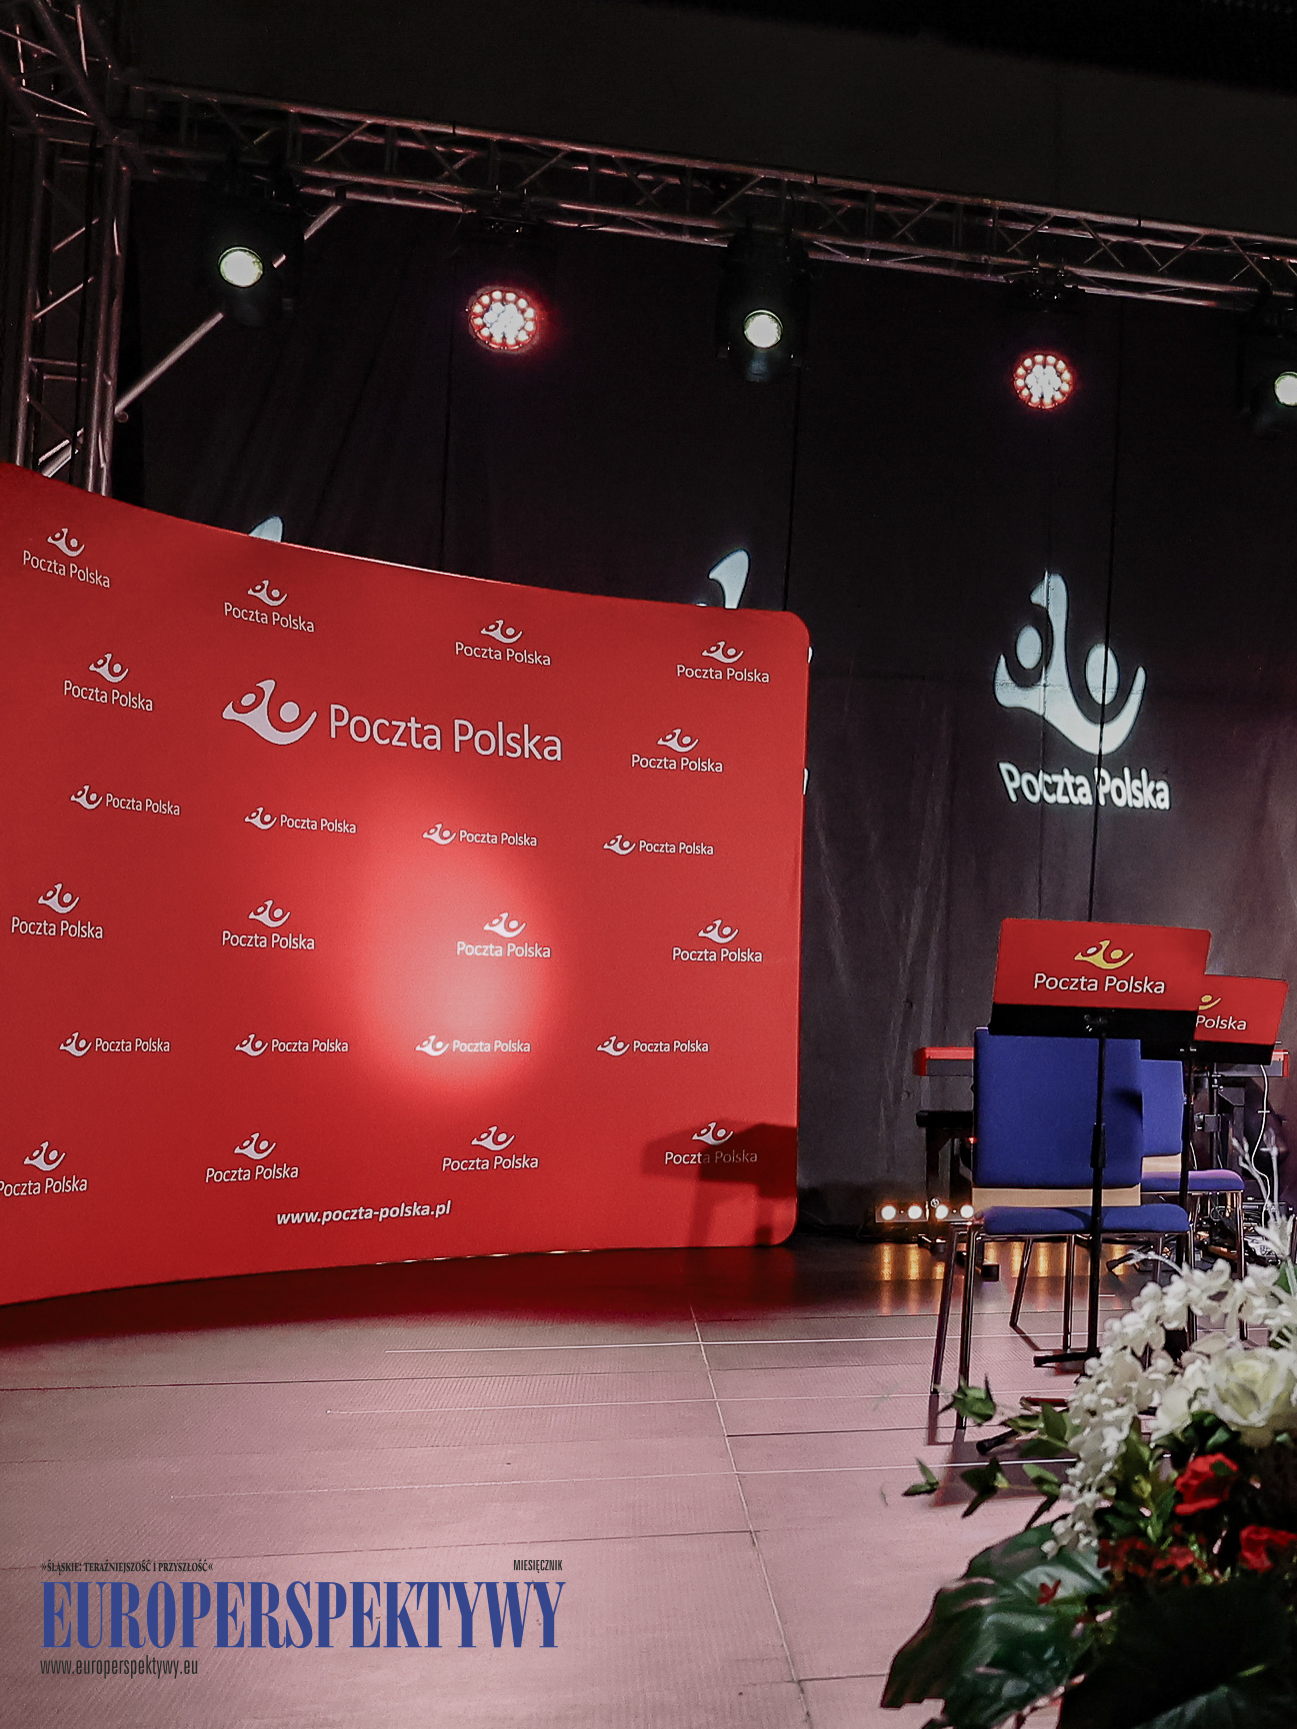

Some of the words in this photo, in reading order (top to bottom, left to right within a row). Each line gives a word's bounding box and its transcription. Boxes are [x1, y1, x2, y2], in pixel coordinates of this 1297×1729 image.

[23, 550, 66, 576] Poczta
[70, 563, 111, 588] Polska
[224, 602, 268, 625] Poczta
[273, 612, 315, 632] Polska
[455, 642, 502, 661] Poczta
[506, 647, 551, 666] Polska
[677, 665, 722, 681] Poczta
[727, 667, 770, 683] Polska
[64, 680, 108, 703] Poczta
[112, 690, 154, 711] Polska
[330, 704, 442, 751] Poczta
[453, 719, 563, 761] Polska
[631, 754, 677, 770] Poczta
[680, 757, 723, 773] Polska
[999, 762, 1093, 806] Poczta
[1094, 767, 1171, 810] Polska
[106, 794, 142, 812] Poczta
[145, 799, 180, 816] Polska
[280, 814, 318, 831] Poczta
[320, 818, 357, 834] Polska
[459, 830, 498, 845] Poczta
[501, 832, 538, 847] Polska
[639, 840, 676, 855] Poczta
[679, 842, 714, 856] Polska
[11, 916, 56, 937] Poczta
[60, 920, 103, 939] Polska
[222, 931, 267, 949] Poczta
[271, 933, 315, 951] Polska
[457, 941, 503, 957] Poczta
[507, 943, 551, 958] Polska
[673, 947, 717, 963] Poczta
[720, 948, 762, 963] Polska
[1033, 973, 1098, 992] Poczta
[1104, 976, 1165, 994] Polska
[1195, 1015, 1247, 1030] Polska
[95, 1038, 132, 1053] Poczta
[135, 1037, 170, 1053] Polska
[271, 1039, 309, 1053] Poczta
[312, 1039, 349, 1053] Polska
[452, 1040, 491, 1053] Poczta
[494, 1040, 531, 1053] Polska
[633, 1040, 670, 1053] Poczta
[673, 1040, 709, 1053] Polska
[442, 1156, 490, 1172] Poczta
[493, 1155, 539, 1170] Polska
[665, 1151, 710, 1166] Poczta
[715, 1150, 758, 1164] Polska
[205, 1164, 251, 1183] Poczta
[255, 1163, 299, 1181] Polska
[0, 1180, 41, 1197] Poczta
[45, 1175, 88, 1194] Polska
[276, 1200, 452, 1226] www.poczta-polska.pl
